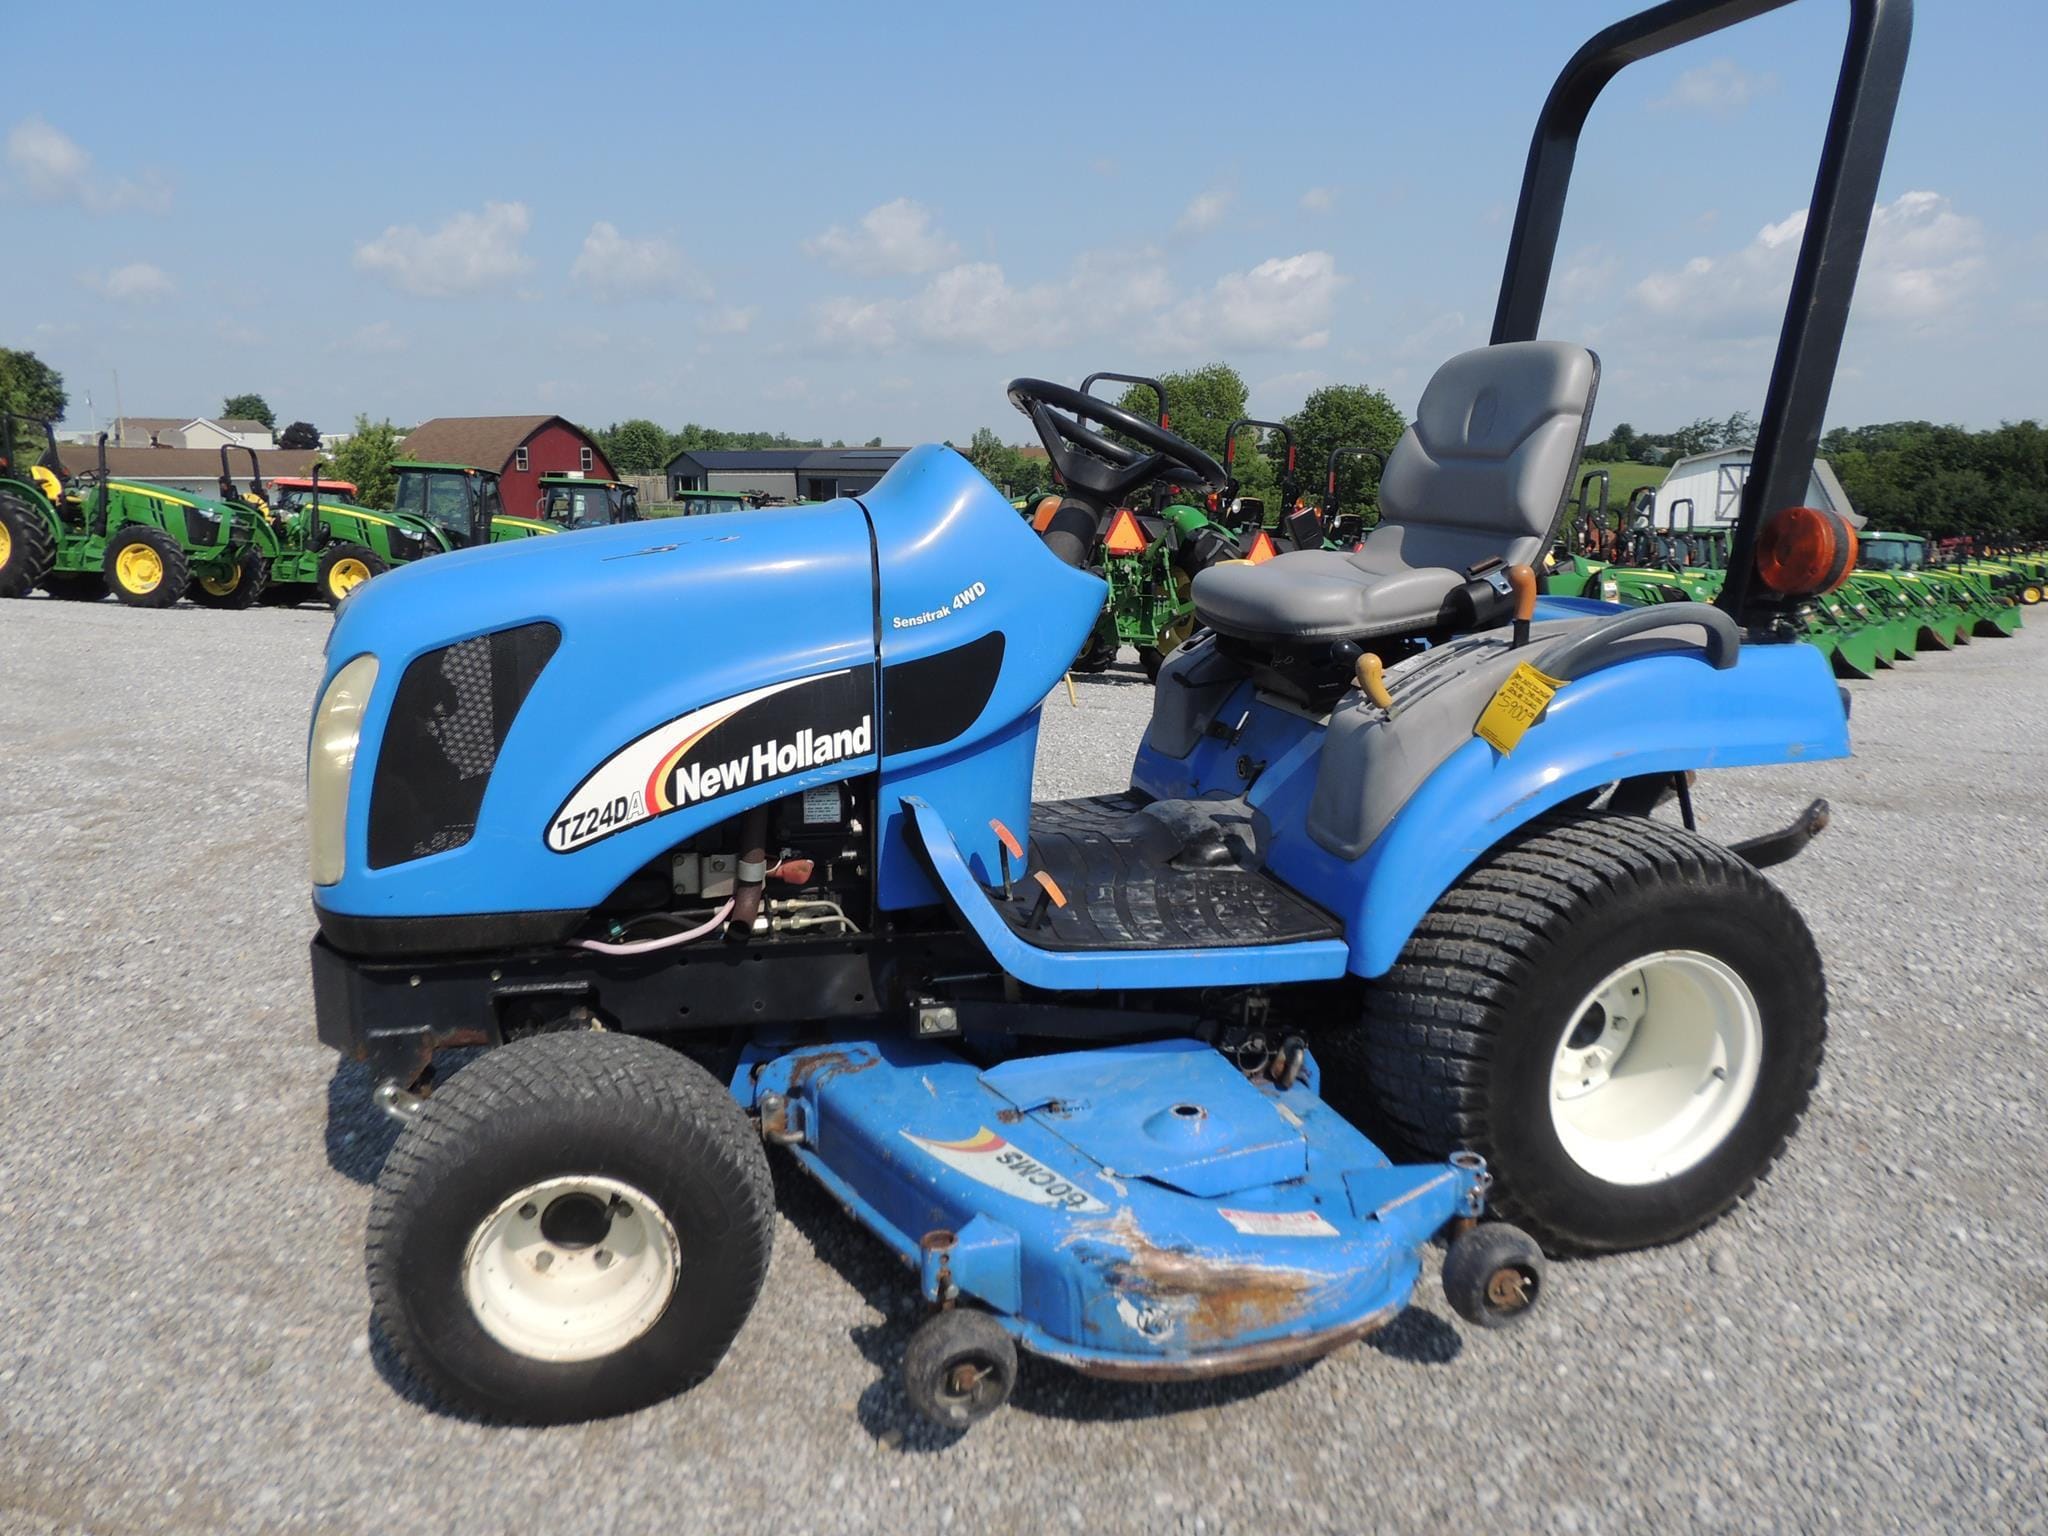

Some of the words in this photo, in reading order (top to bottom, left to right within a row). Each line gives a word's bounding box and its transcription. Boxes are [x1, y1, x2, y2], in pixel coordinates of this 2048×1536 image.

[893, 606, 951, 628] Sensitrak
[952, 581, 986, 609] 4WD
[676, 756, 749, 806] New
[752, 715, 872, 782] Holland
[557, 791, 645, 846] TZ24DA
[996, 1152, 1088, 1206] 60CMS
